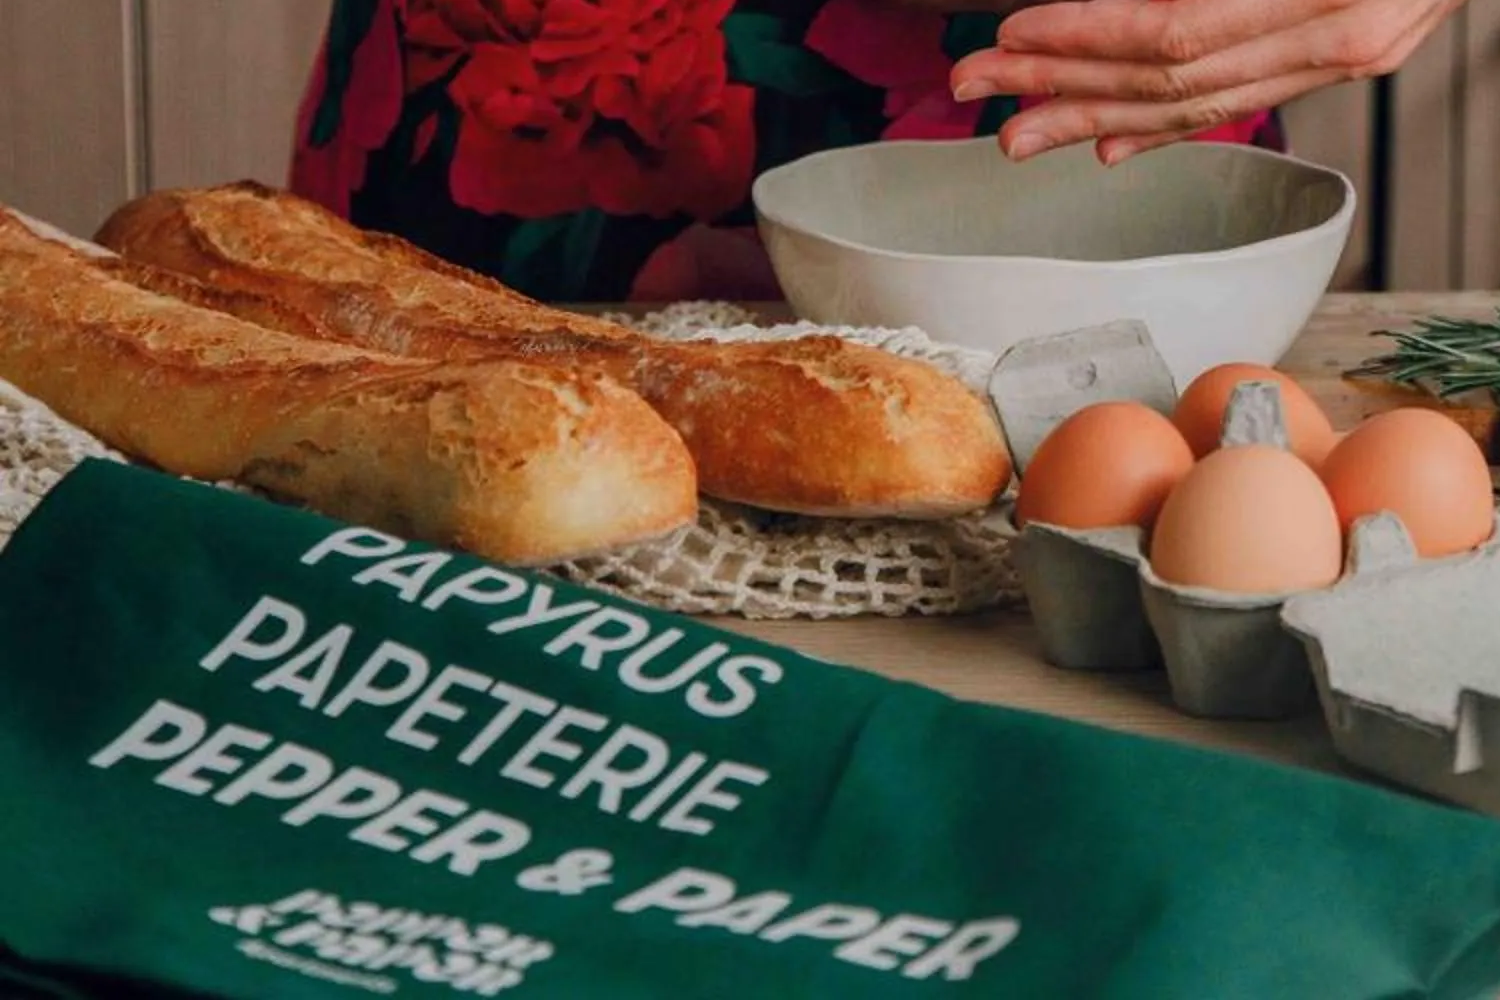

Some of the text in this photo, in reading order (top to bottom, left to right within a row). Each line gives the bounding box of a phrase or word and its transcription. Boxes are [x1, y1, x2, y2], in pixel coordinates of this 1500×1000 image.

[199, 595, 770, 836] PAPETERIE
[301, 525, 784, 718] PAPYRUS
[89, 699, 531, 876] PEPPER
[516, 848, 613, 895] &
[614, 867, 1019, 981] PAPER
